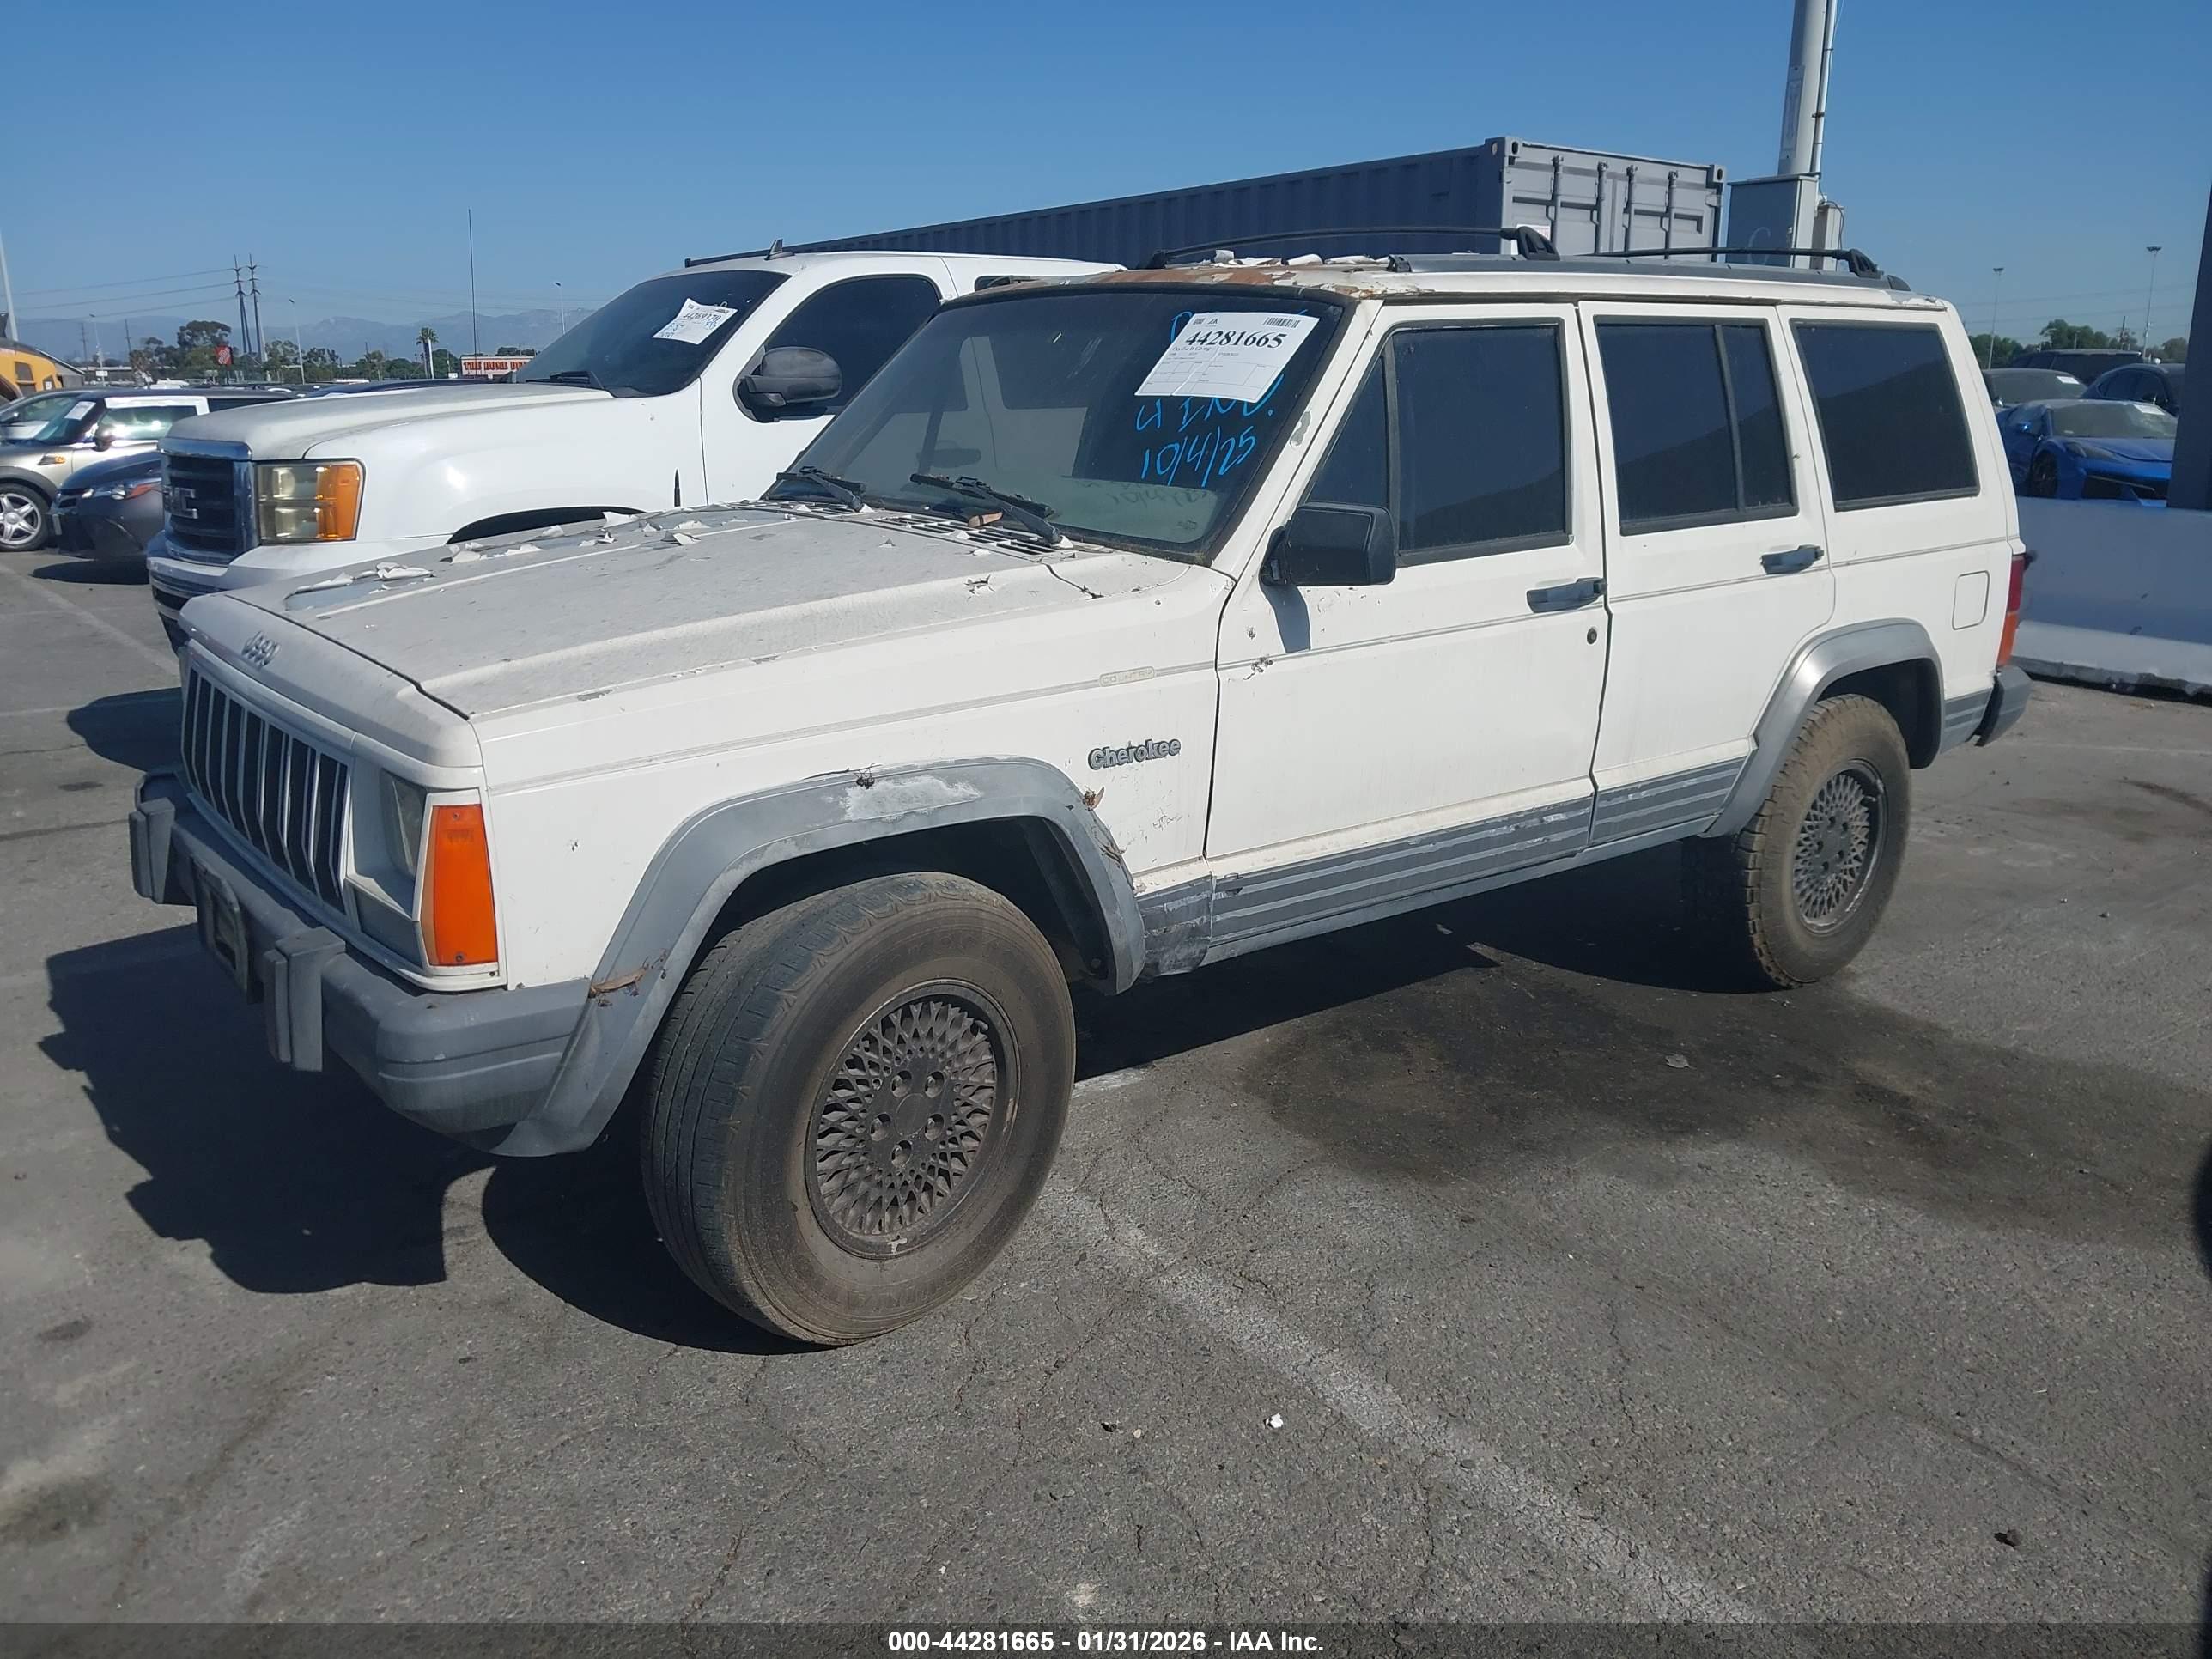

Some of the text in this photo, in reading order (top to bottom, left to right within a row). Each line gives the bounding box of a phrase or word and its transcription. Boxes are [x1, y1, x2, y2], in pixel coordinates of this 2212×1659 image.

[1186, 330, 1287, 349] 44281665
[464, 361, 482, 370] THE
[1140, 426, 1258, 488] 10/4/25
[1088, 738, 1182, 770] Cherokee
